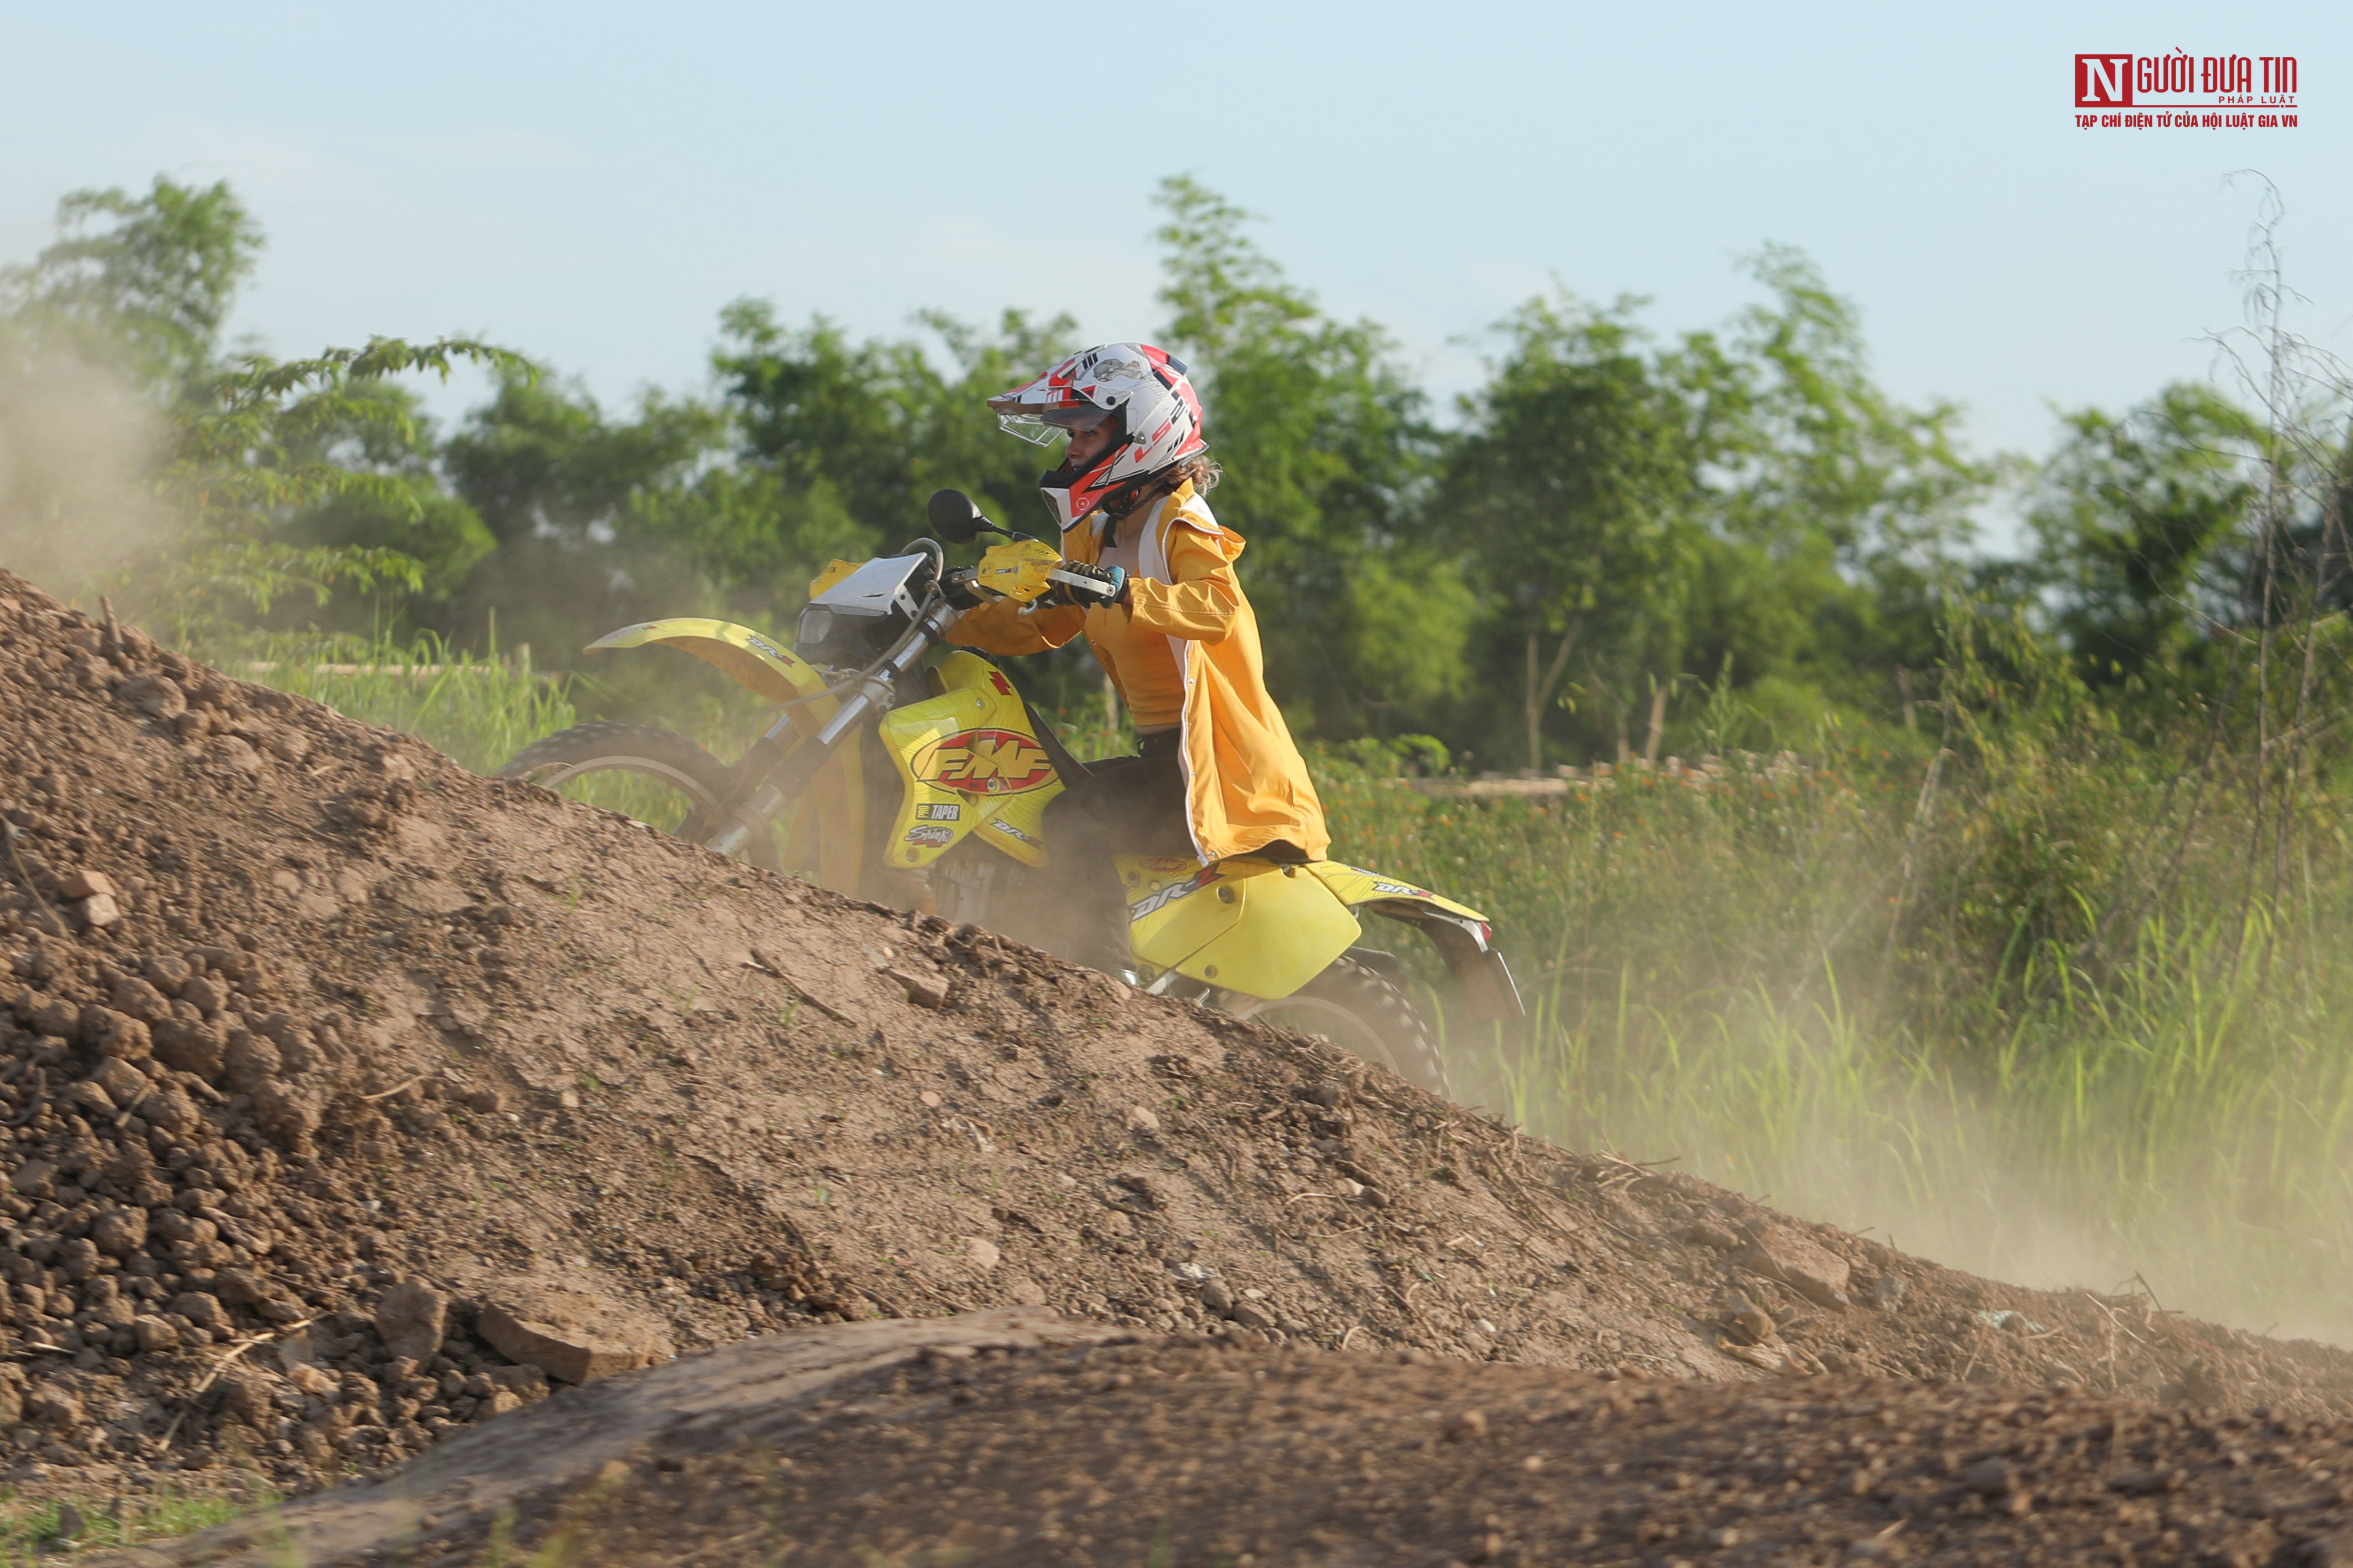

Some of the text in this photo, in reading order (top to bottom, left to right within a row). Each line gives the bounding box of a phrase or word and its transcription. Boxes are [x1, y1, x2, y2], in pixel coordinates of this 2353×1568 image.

[1134, 397, 1186, 463] LS2
[918, 739, 1052, 781] FMF
[918, 805, 959, 820] PRO TAPER
[1132, 865, 1221, 921] DR-Z
